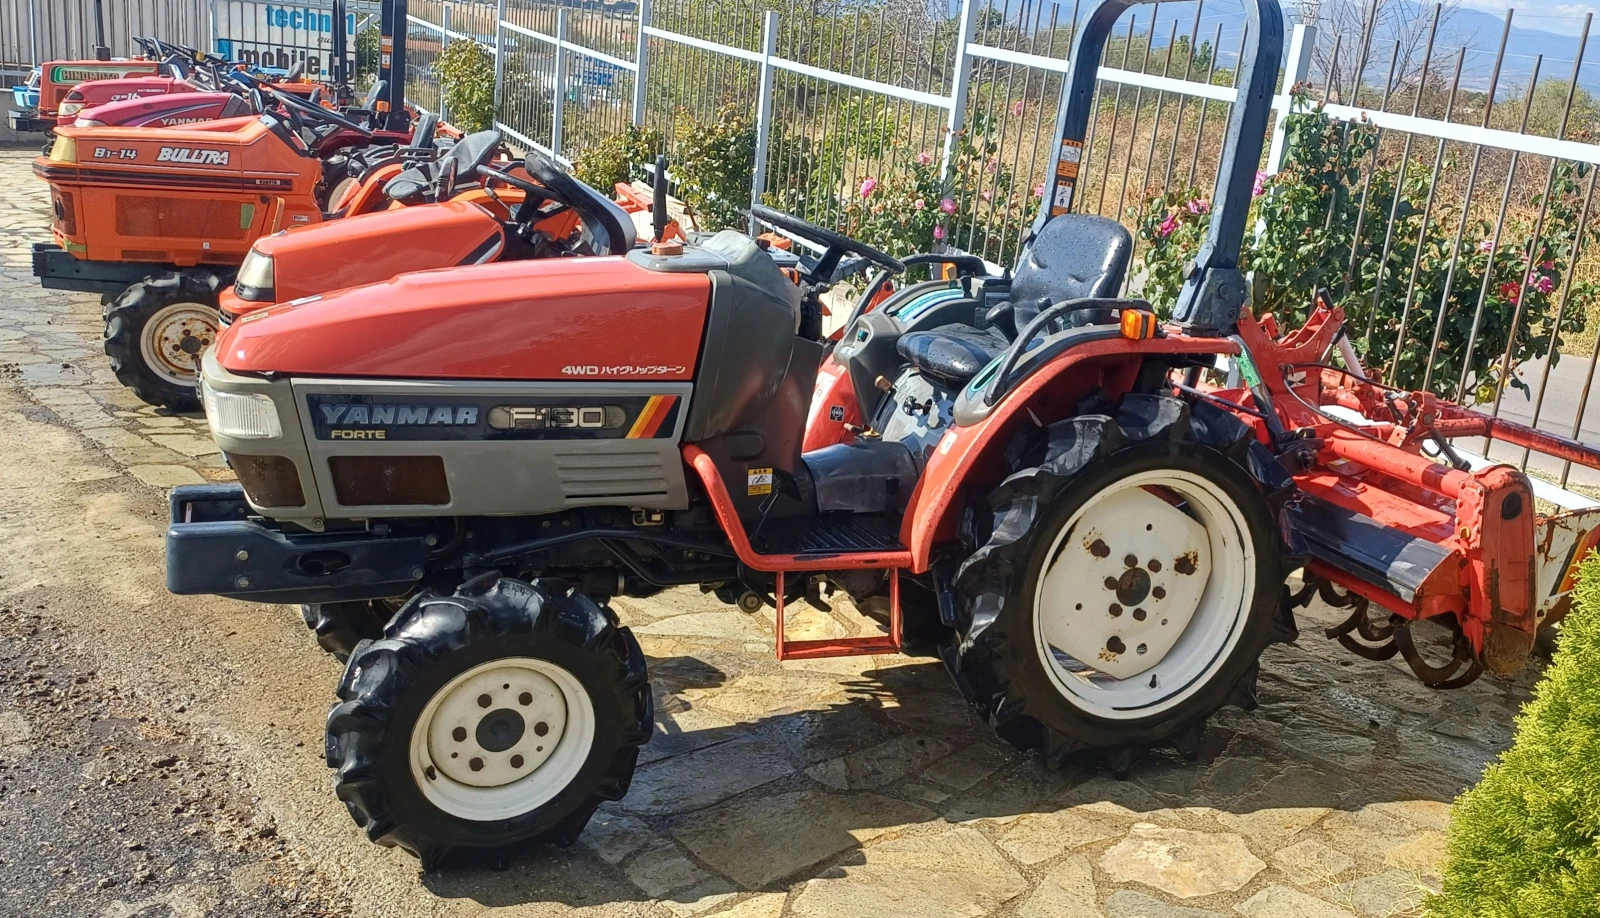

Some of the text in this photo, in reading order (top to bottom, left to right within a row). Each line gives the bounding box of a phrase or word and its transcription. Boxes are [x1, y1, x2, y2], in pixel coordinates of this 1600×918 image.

[265, 4, 354, 35] techn1
[156, 147, 230, 166] BULLTRA
[561, 365, 686, 375] 4WD ハイグリップターン
[320, 405, 479, 425] YANMAR
[331, 430, 386, 439] FORTE
